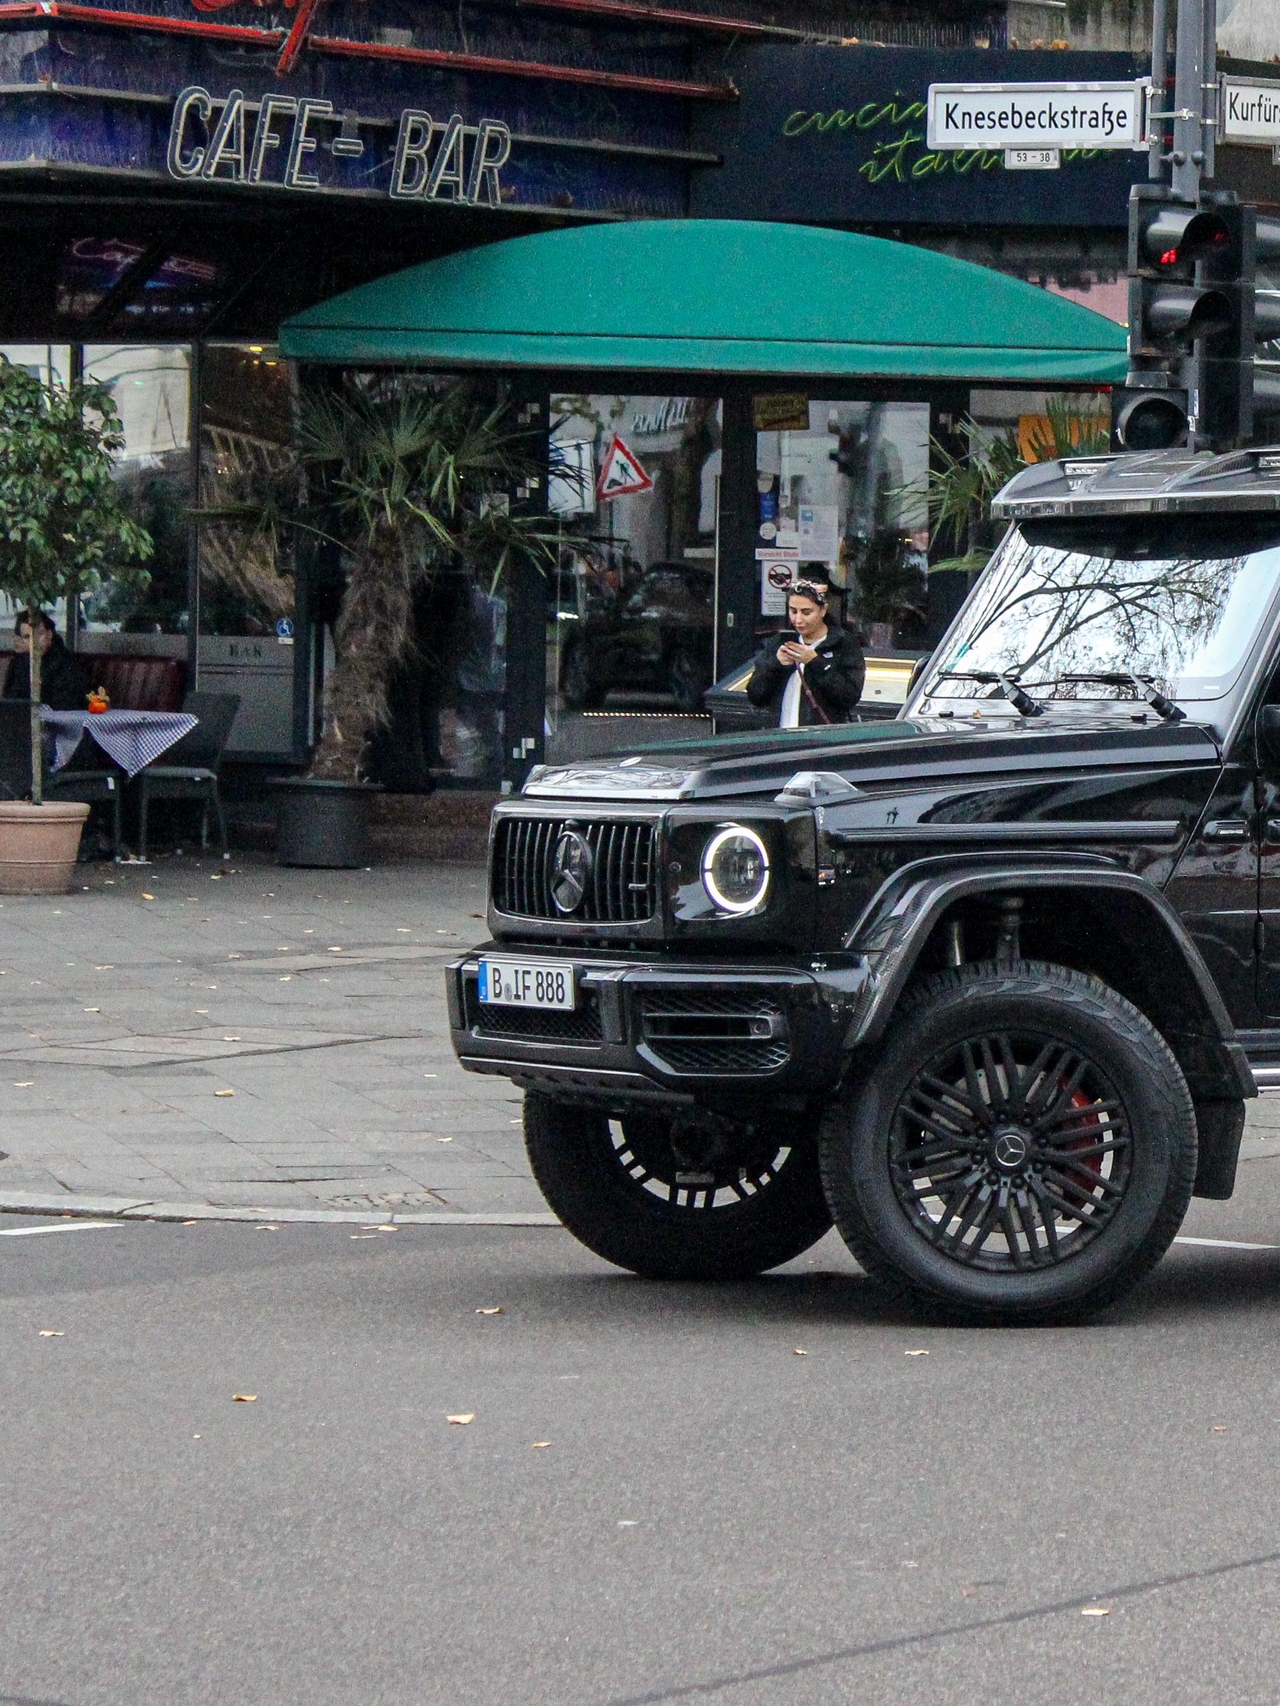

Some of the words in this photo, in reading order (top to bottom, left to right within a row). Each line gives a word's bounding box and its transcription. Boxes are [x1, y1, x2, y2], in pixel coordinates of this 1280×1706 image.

[945, 102, 1128, 136] Knesebeckstraße
[390, 108, 511, 208] BAR
[492, 967, 503, 998] B
[513, 969, 531, 1001] IF
[535, 971, 565, 1004] 888
